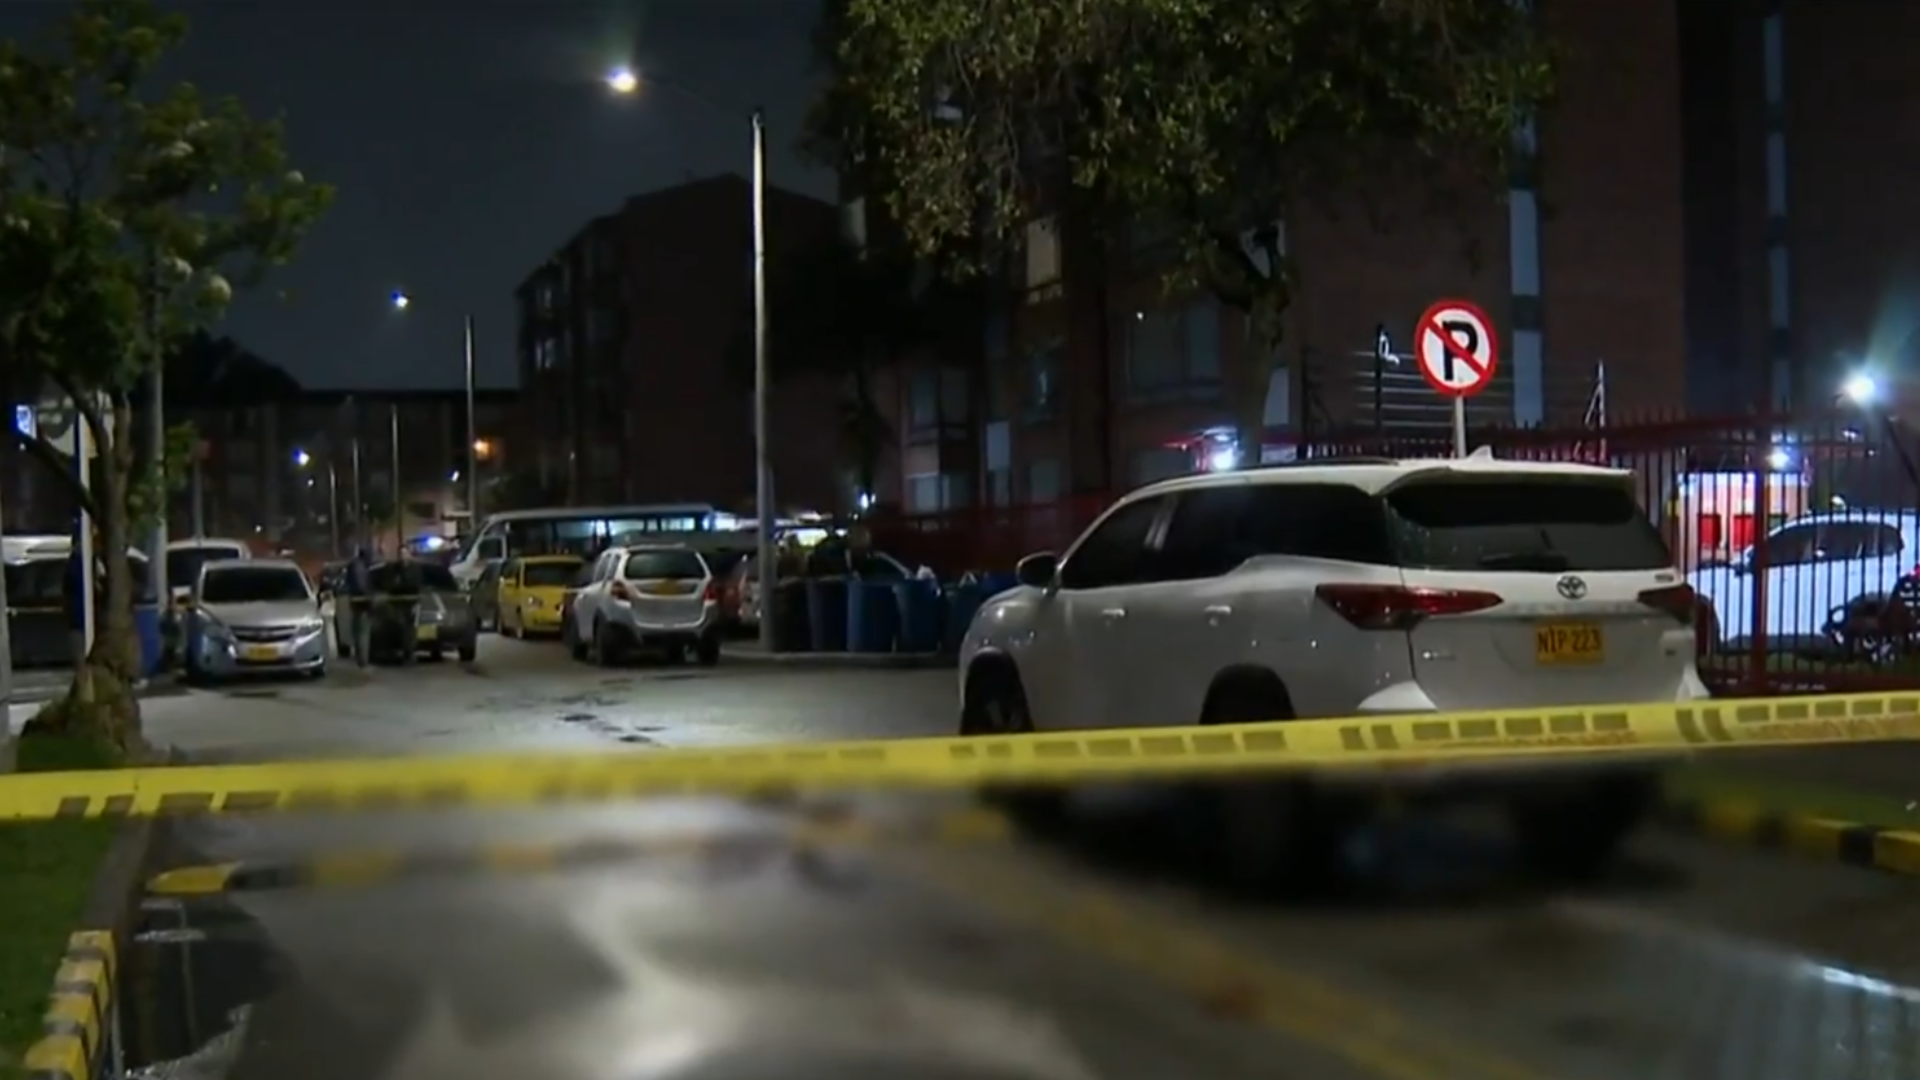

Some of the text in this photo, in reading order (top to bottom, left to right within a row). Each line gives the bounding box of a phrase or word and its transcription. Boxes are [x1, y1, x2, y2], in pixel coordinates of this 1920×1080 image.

[1443, 321, 1478, 381] P
[1537, 626, 1602, 652] NIP 223
